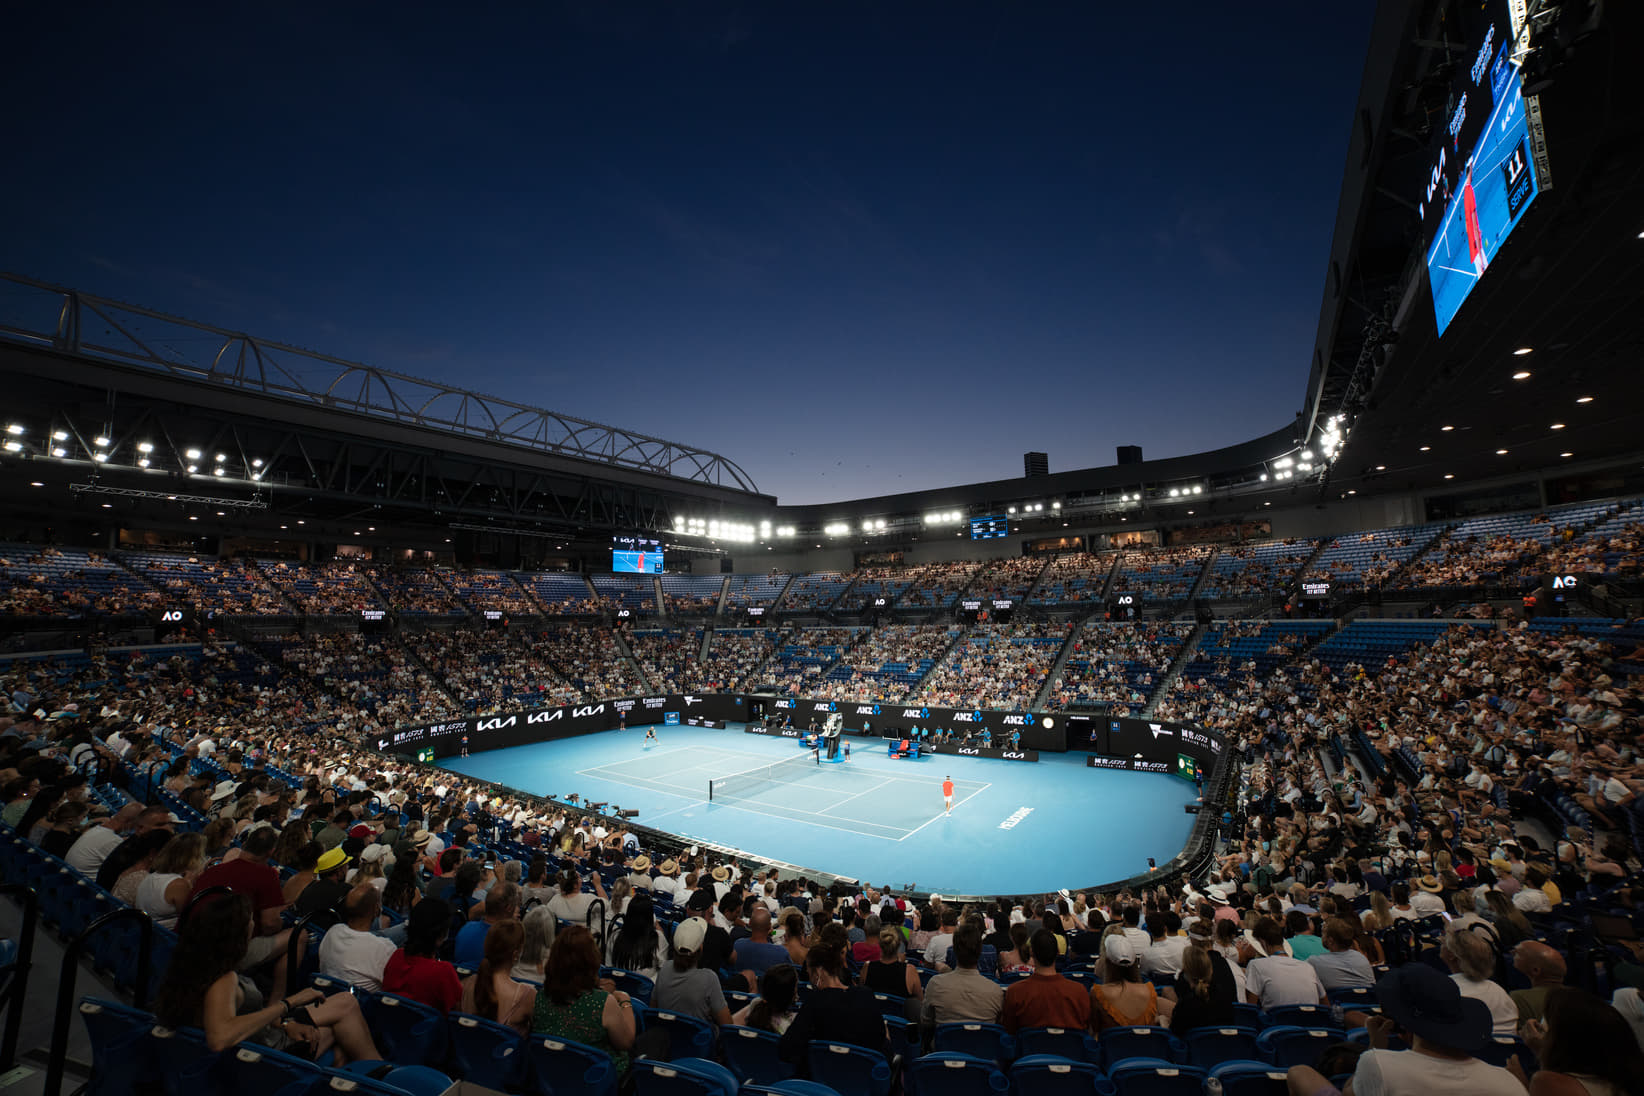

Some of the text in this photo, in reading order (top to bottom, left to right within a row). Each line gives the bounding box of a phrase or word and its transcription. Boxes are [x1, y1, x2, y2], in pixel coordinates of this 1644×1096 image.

[1508, 150, 1523, 184] 11
[1511, 177, 1529, 210] SERVE
[1118, 596, 1133, 605] AO
[161, 611, 183, 621] AO
[814, 703, 830, 712] ANZ
[856, 706, 873, 715] ANZ
[902, 709, 921, 718] ANZ
[953, 712, 973, 722] ANZ
[1003, 715, 1025, 725] ANZ
